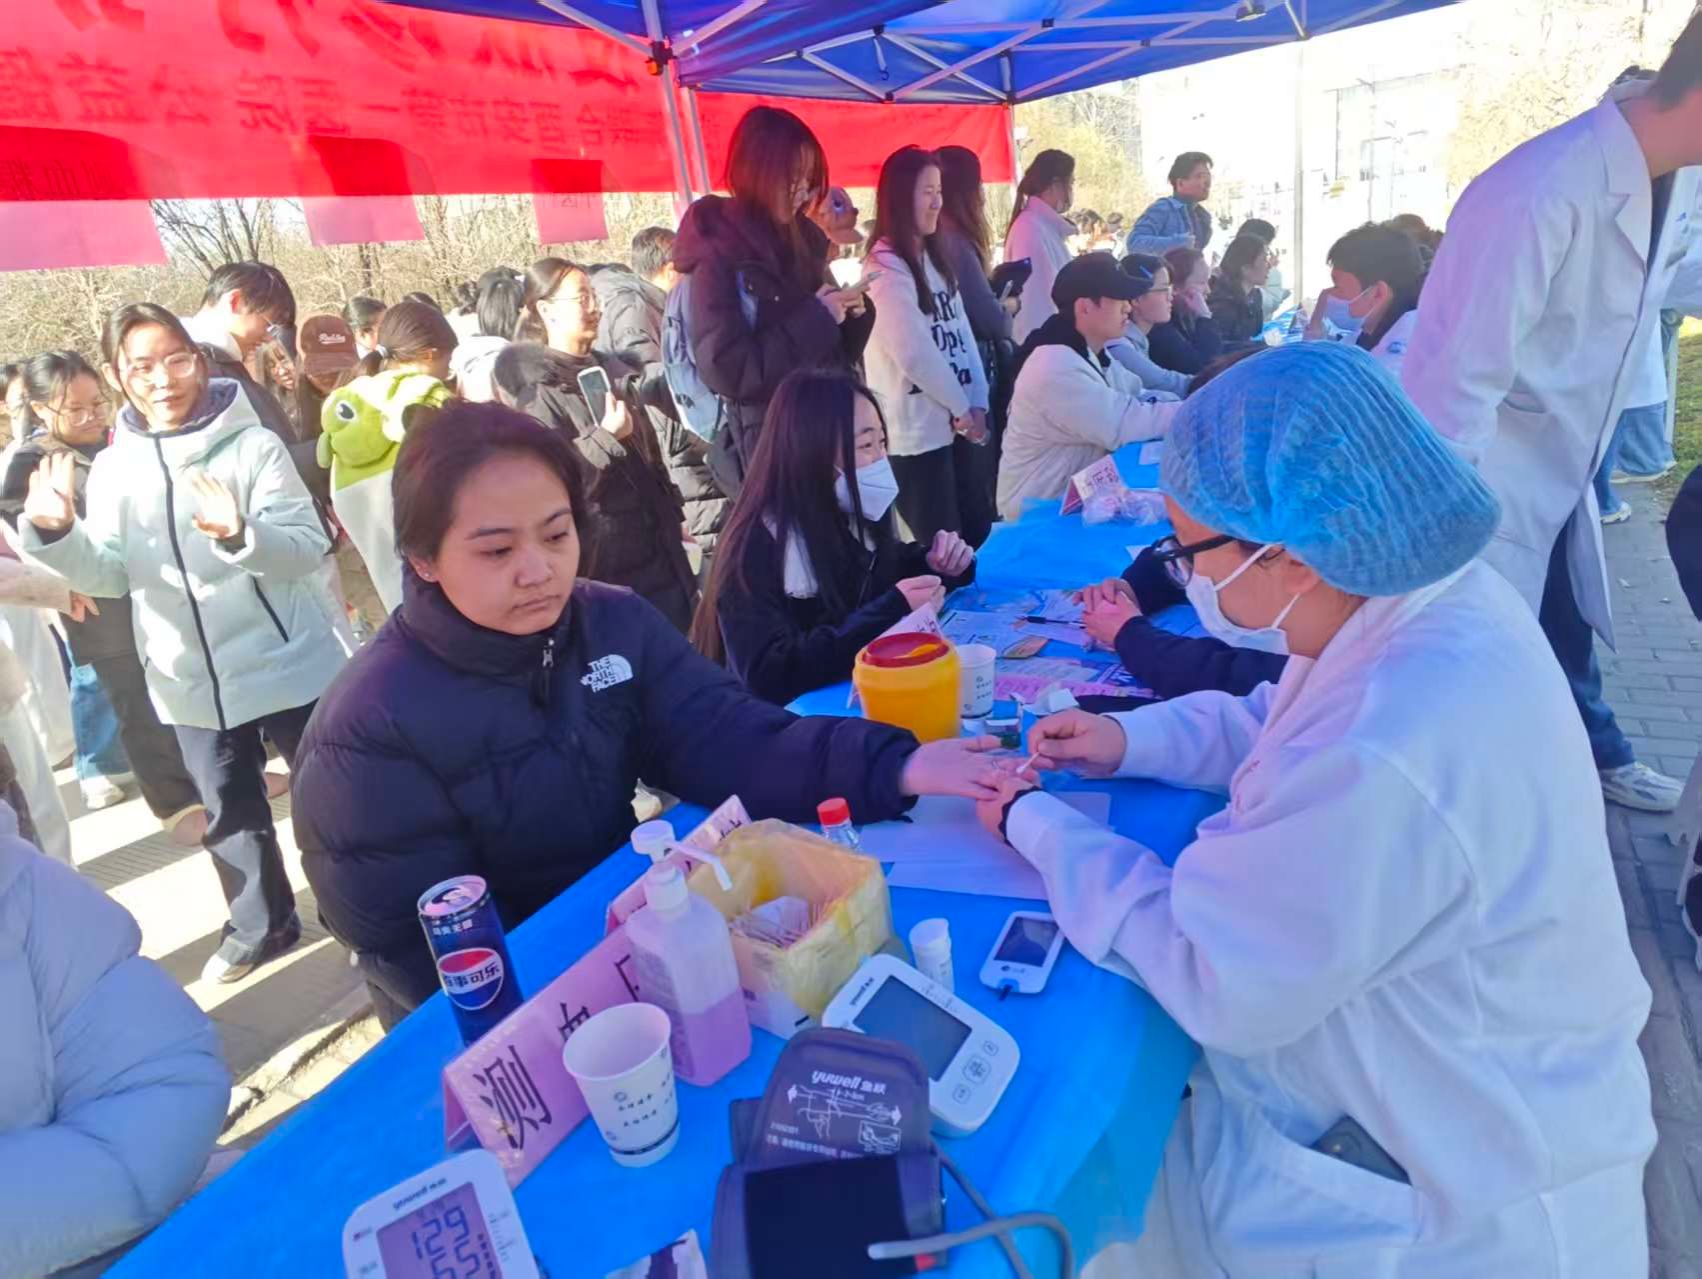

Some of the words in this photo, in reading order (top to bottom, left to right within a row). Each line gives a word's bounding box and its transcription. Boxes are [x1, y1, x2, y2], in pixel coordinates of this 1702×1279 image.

[588, 656, 610, 673] THE
[580, 665, 615, 686] NORTH
[592, 675, 617, 693] FACE
[811, 1069, 862, 1091] yuwell
[411, 1205, 470, 1260] 129
